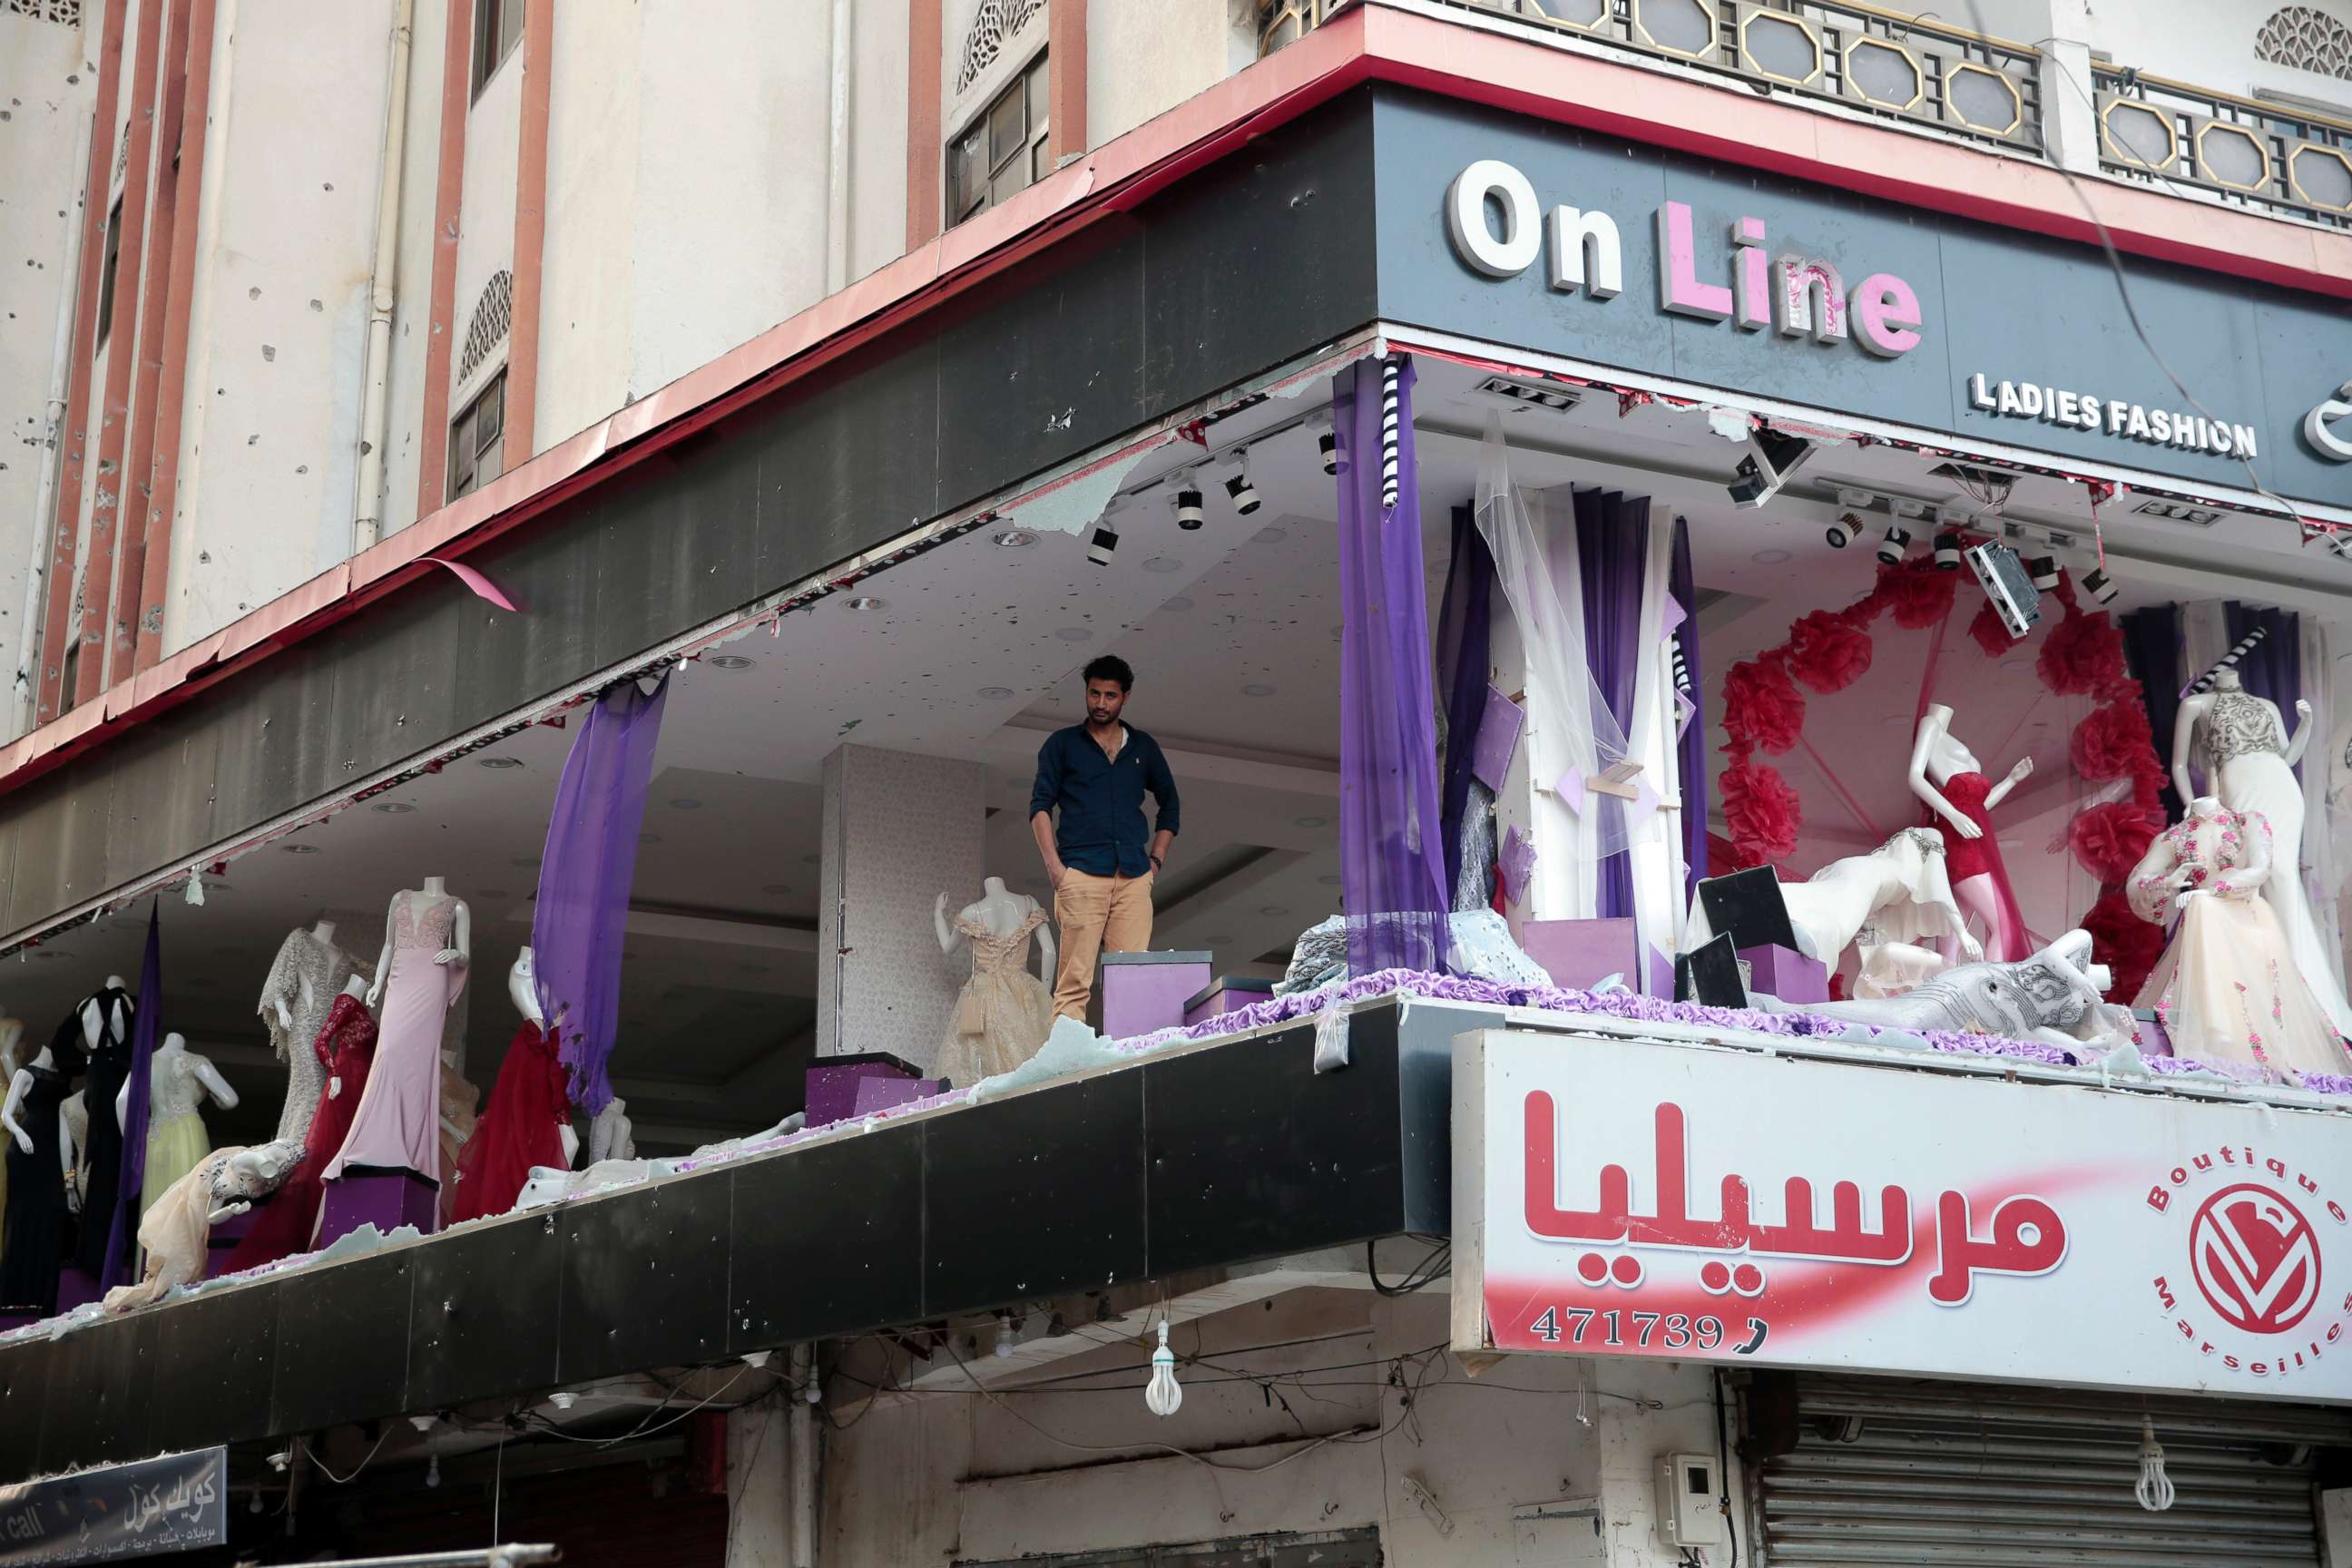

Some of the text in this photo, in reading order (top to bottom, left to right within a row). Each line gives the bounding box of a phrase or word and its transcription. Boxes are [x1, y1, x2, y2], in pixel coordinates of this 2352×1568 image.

[1447, 160, 1922, 358] On Line
[1969, 372, 2102, 430] LADIES
[2105, 399, 2258, 459] FASHION
[1524, 1089, 2065, 1303] مرسيليا
[2147, 1146, 2347, 1222] Boutique
[1530, 1307, 1724, 1350] 471739
[7, 1505, 44, 1540] call
[167, 1472, 215, 1523] كويك
